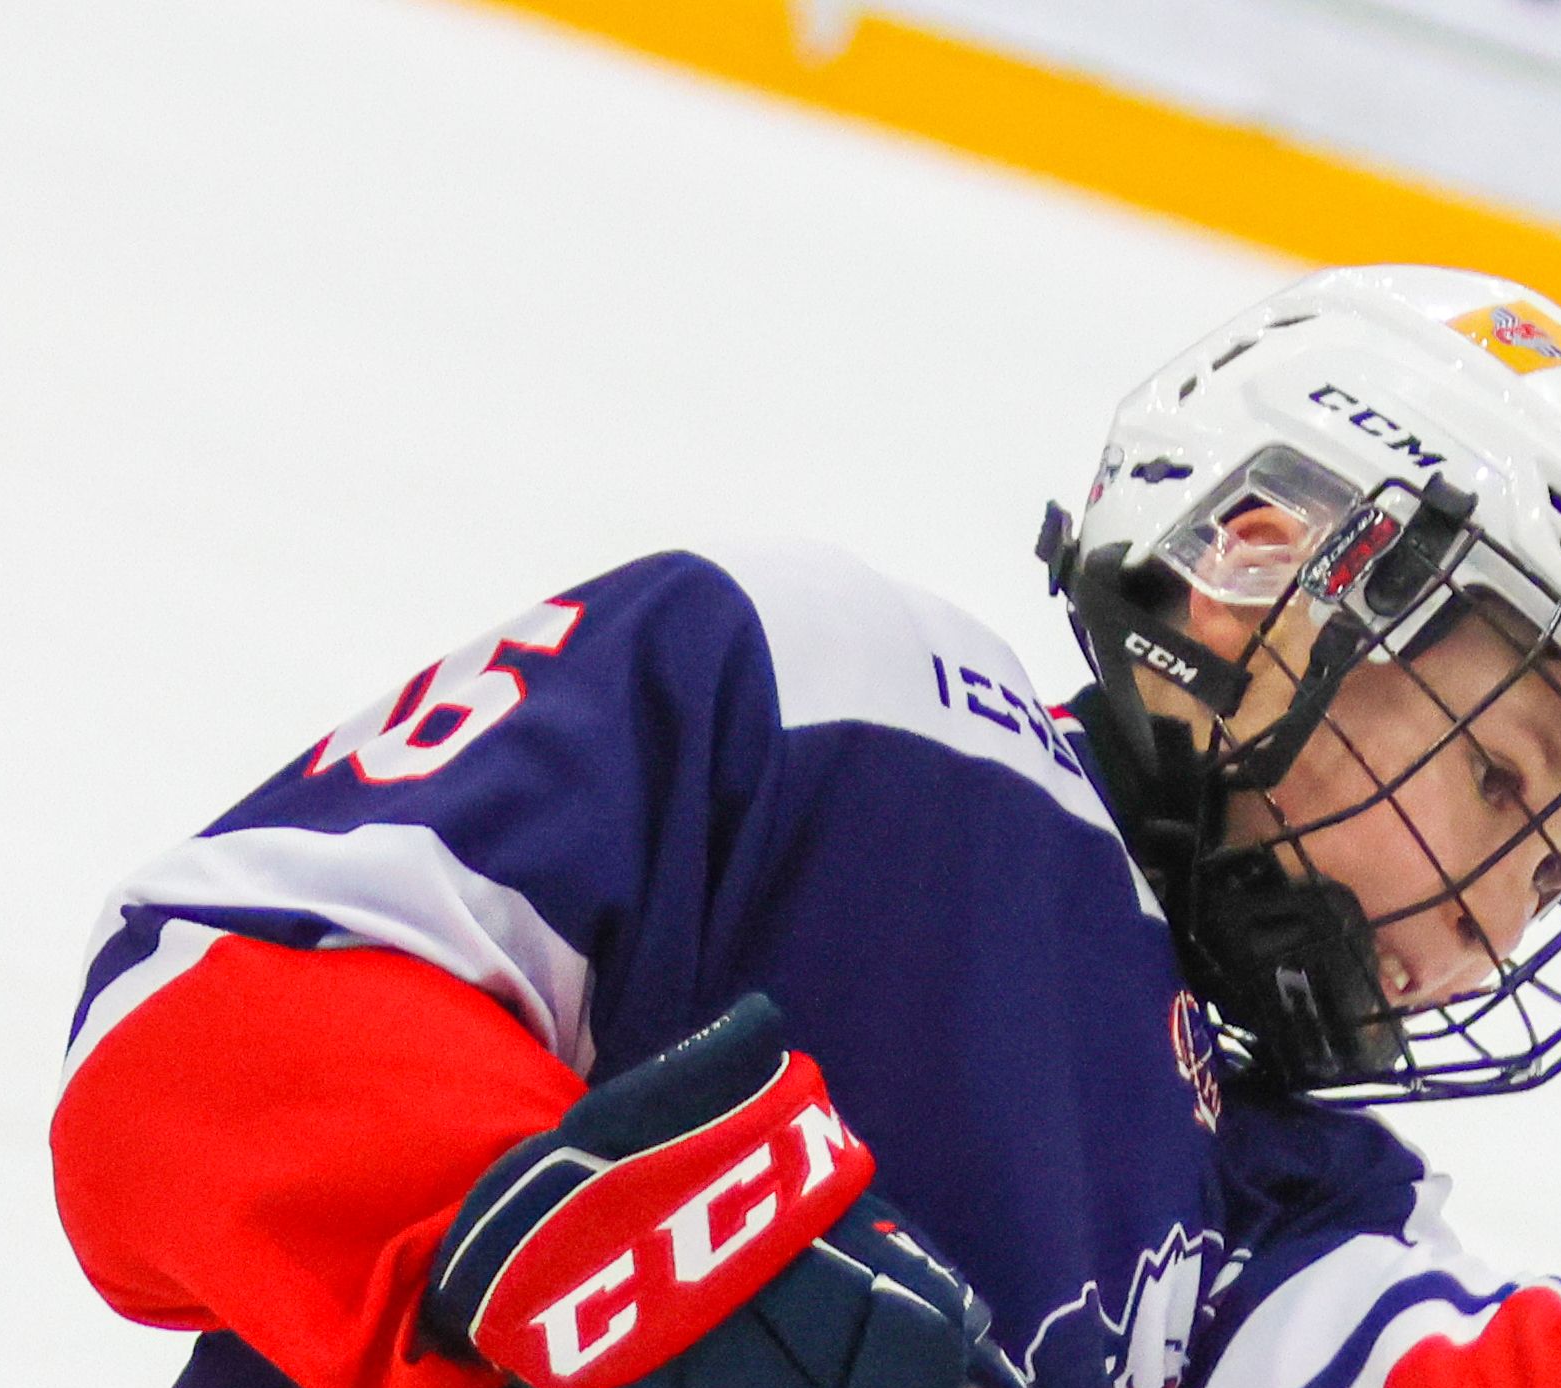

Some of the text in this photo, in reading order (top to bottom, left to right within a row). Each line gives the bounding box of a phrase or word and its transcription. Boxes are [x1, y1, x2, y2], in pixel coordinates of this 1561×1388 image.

[1308, 382, 1447, 467] CCM
[1124, 631, 1198, 684] CCM
[528, 1102, 863, 1378] CCM
